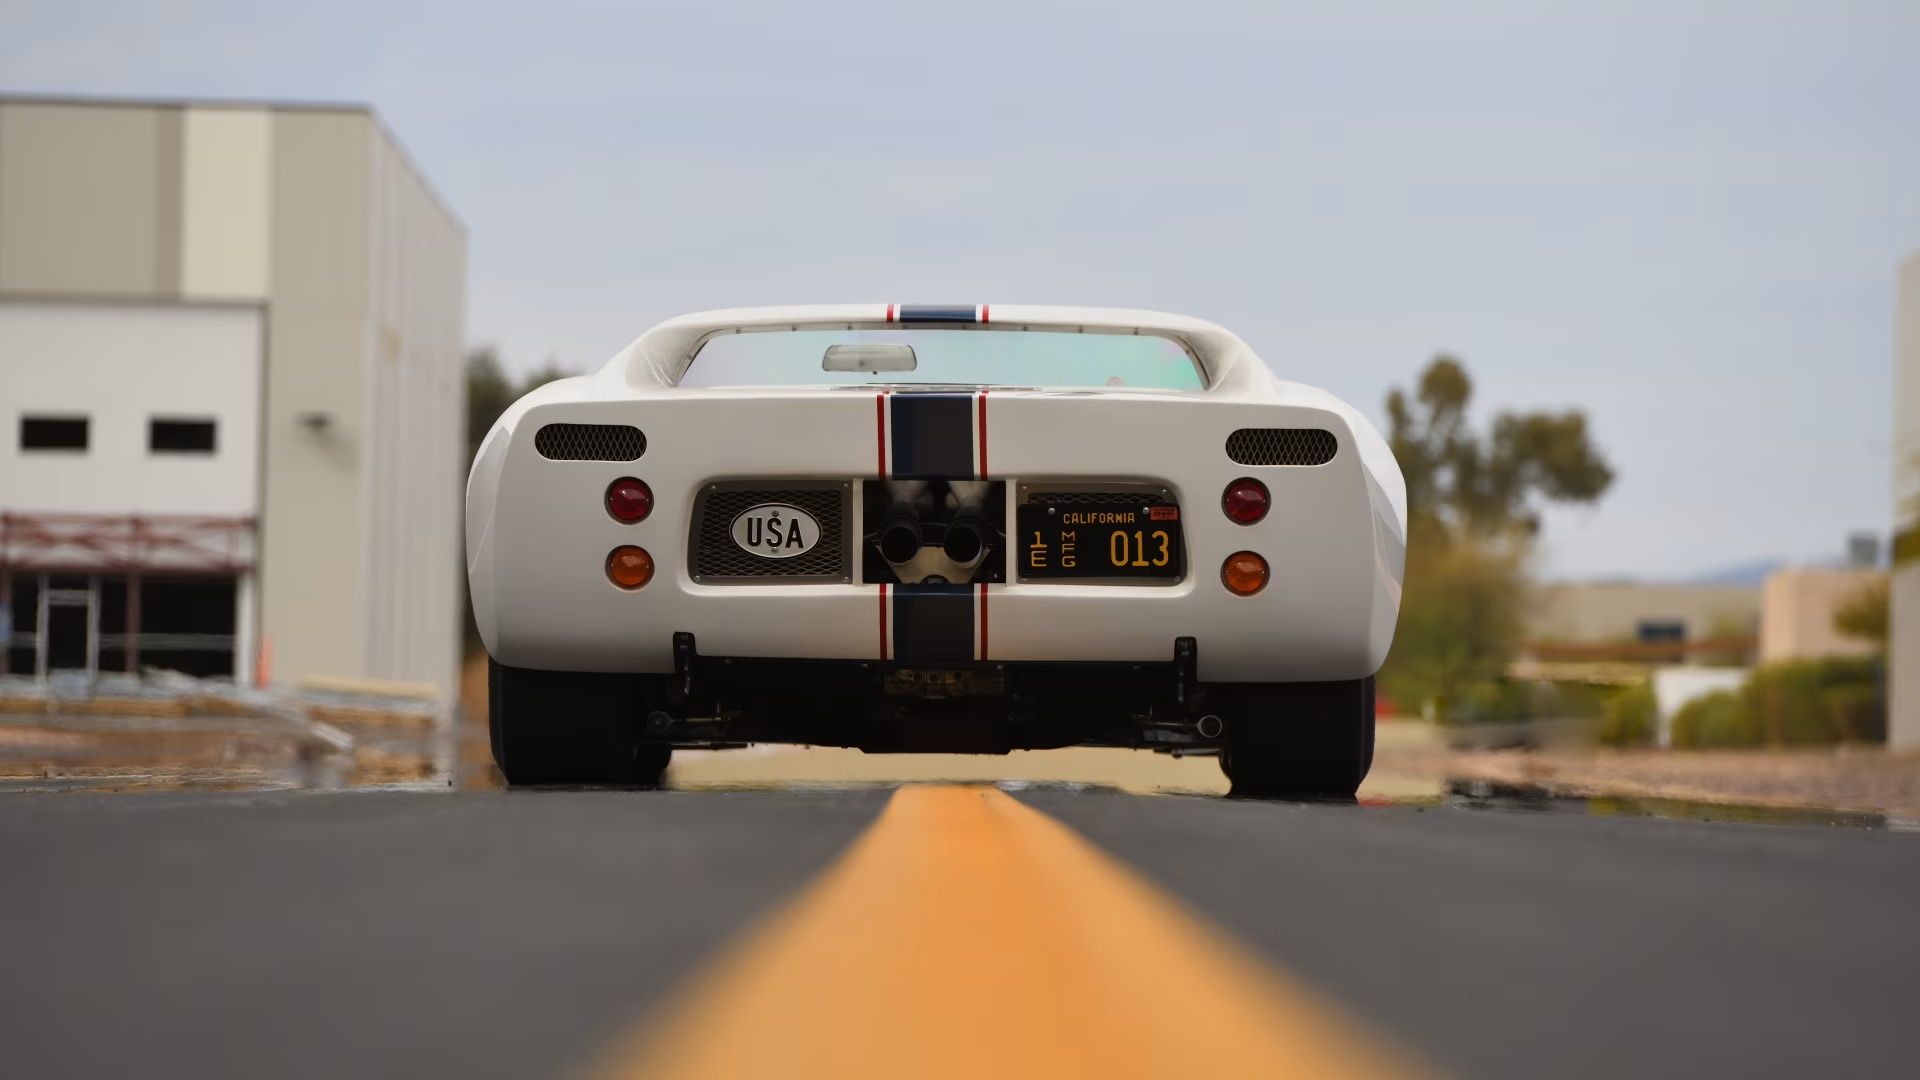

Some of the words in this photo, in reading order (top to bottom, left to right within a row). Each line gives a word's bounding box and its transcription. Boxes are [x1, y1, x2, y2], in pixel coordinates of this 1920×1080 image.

[747, 517, 804, 548] USA
[1063, 512, 1135, 524] CALIFORNIA
[1110, 530, 1169, 567] 013
